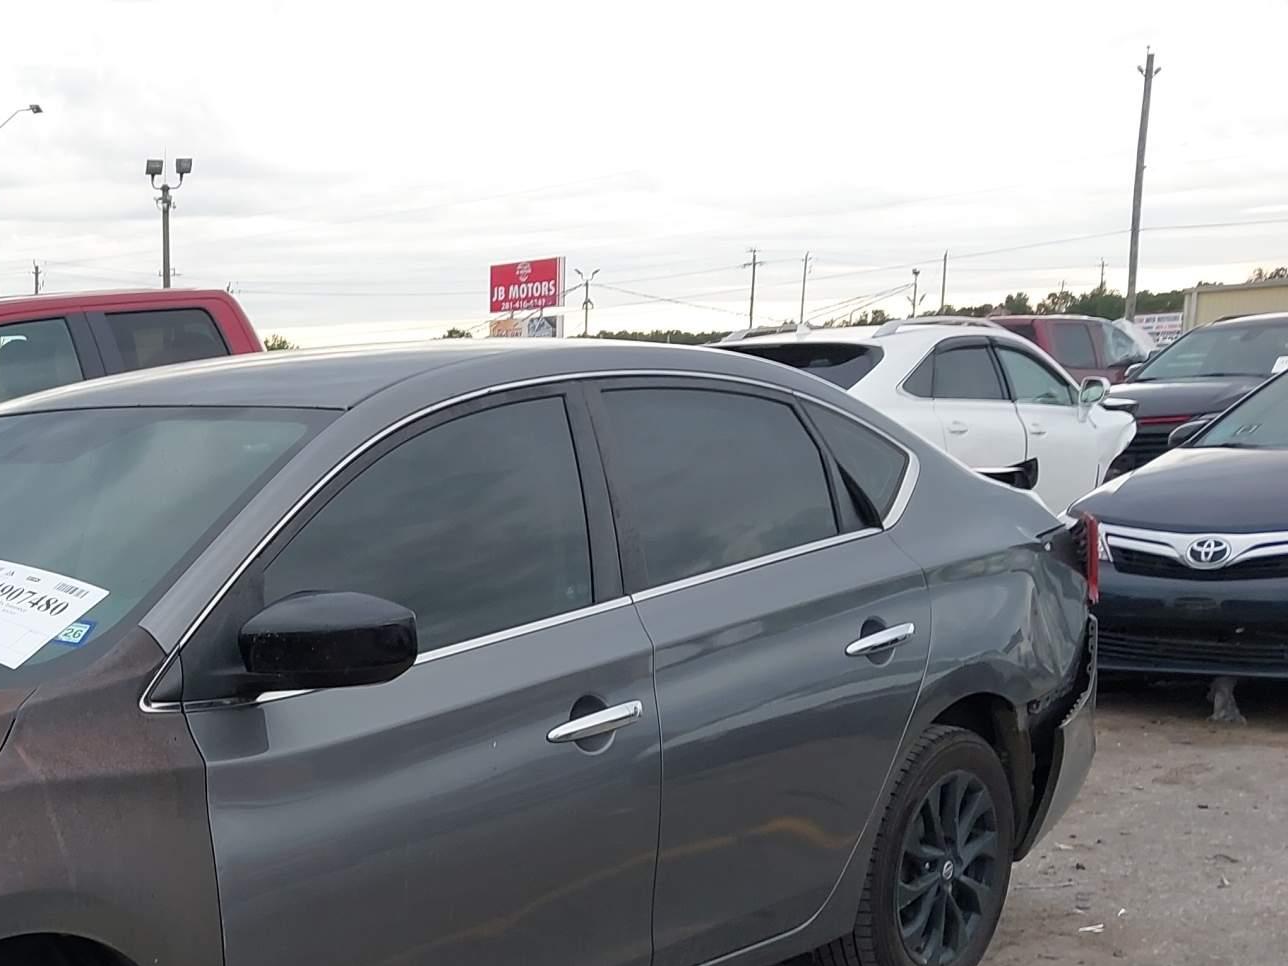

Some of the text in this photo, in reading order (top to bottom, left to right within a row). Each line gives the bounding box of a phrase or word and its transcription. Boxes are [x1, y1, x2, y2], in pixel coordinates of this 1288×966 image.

[493, 280, 555, 302] JB MOTORS
[62, 628, 83, 639] 26
